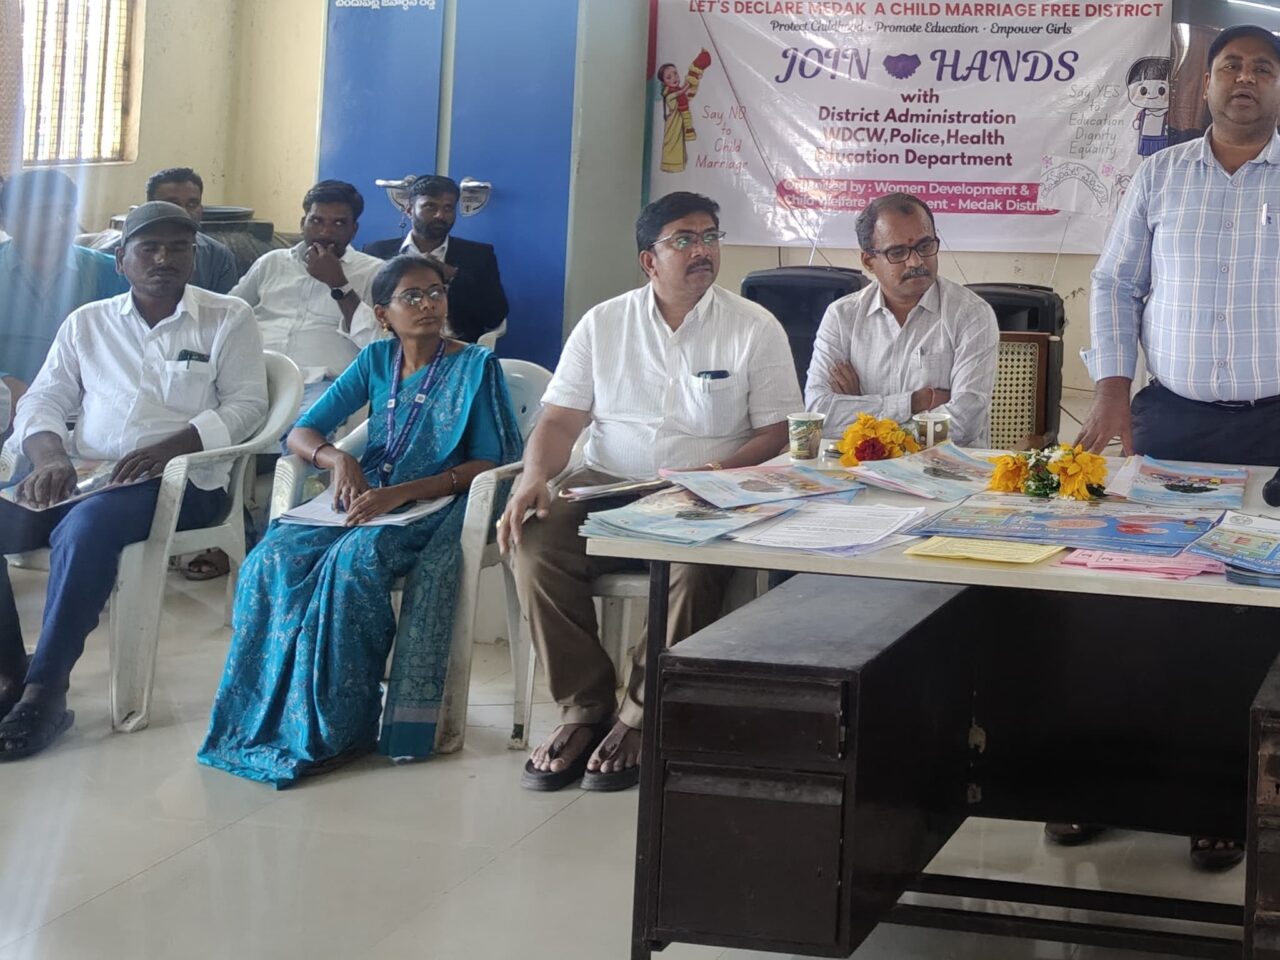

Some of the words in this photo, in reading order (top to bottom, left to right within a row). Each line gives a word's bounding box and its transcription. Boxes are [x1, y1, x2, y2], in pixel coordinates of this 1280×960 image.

[689, 0, 730, 14] LET'S
[734, 1, 805, 15] DECLARE
[808, 2, 866, 15] MEDAK
[875, 3, 885, 15] A
[890, 3, 940, 16] CHILD
[945, 2, 1036, 17] MARRIAGE
[1041, 2, 1080, 17] FREE
[1085, 2, 1163, 17] DISTRICT
[770, 20, 808, 32] Protect
[874, 21, 921, 33] Promote
[924, 22, 979, 34] Education
[990, 23, 1044, 38] Empower
[1046, 23, 1072, 34] Girls
[774, 47, 871, 84] JOIN
[930, 49, 1079, 82] HANDS
[900, 88, 939, 103] with
[1069, 84, 1091, 103] Say
[1096, 84, 1120, 98] YES
[1088, 99, 1100, 111] to
[702, 105, 724, 125] Say
[729, 105, 746, 120] NO
[818, 106, 880, 122] District
[884, 107, 1016, 125] Administration
[1069, 112, 1124, 126] Education
[721, 121, 732, 136] to
[1075, 126, 1117, 146] Dignity
[714, 137, 743, 152] Child
[1069, 140, 1117, 161] Equality
[695, 154, 749, 174] Marriage
[905, 148, 1013, 169] Department
[850, 181, 866, 195] by
[874, 181, 926, 194] Women
[928, 182, 1018, 197] Development
[1020, 184, 1030, 195] &
[958, 199, 1002, 210] Medak
